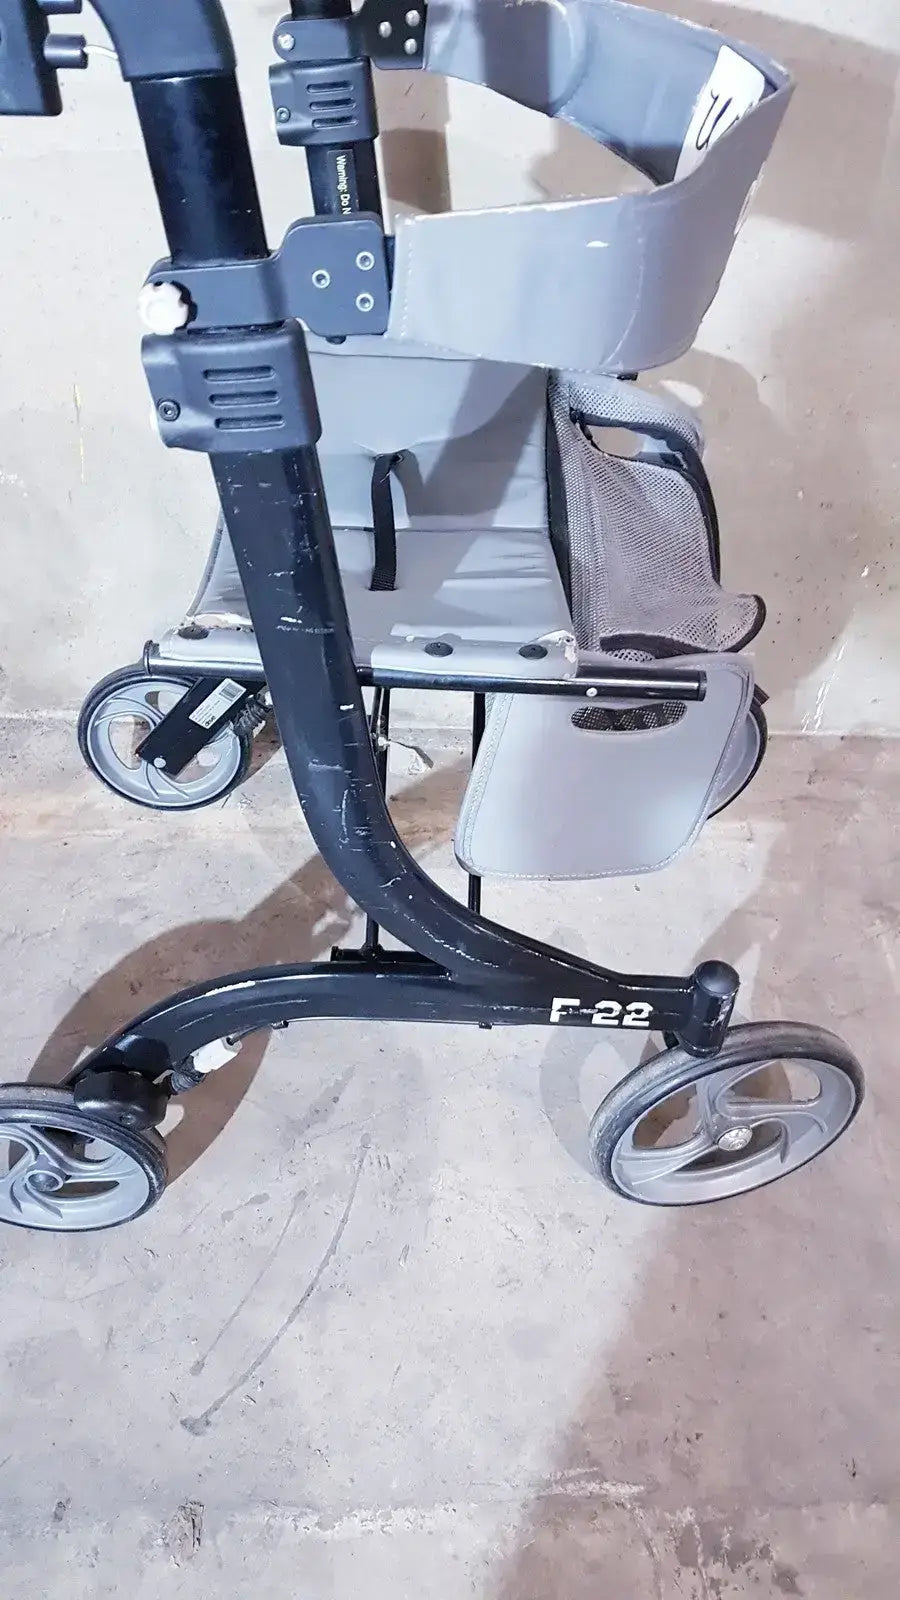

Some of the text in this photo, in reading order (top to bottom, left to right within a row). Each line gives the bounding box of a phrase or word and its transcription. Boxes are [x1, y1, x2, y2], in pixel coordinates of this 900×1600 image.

[336, 155, 348, 192] Warning:
[340, 193, 350, 206] Do
[550, 997, 653, 1027] F-22
